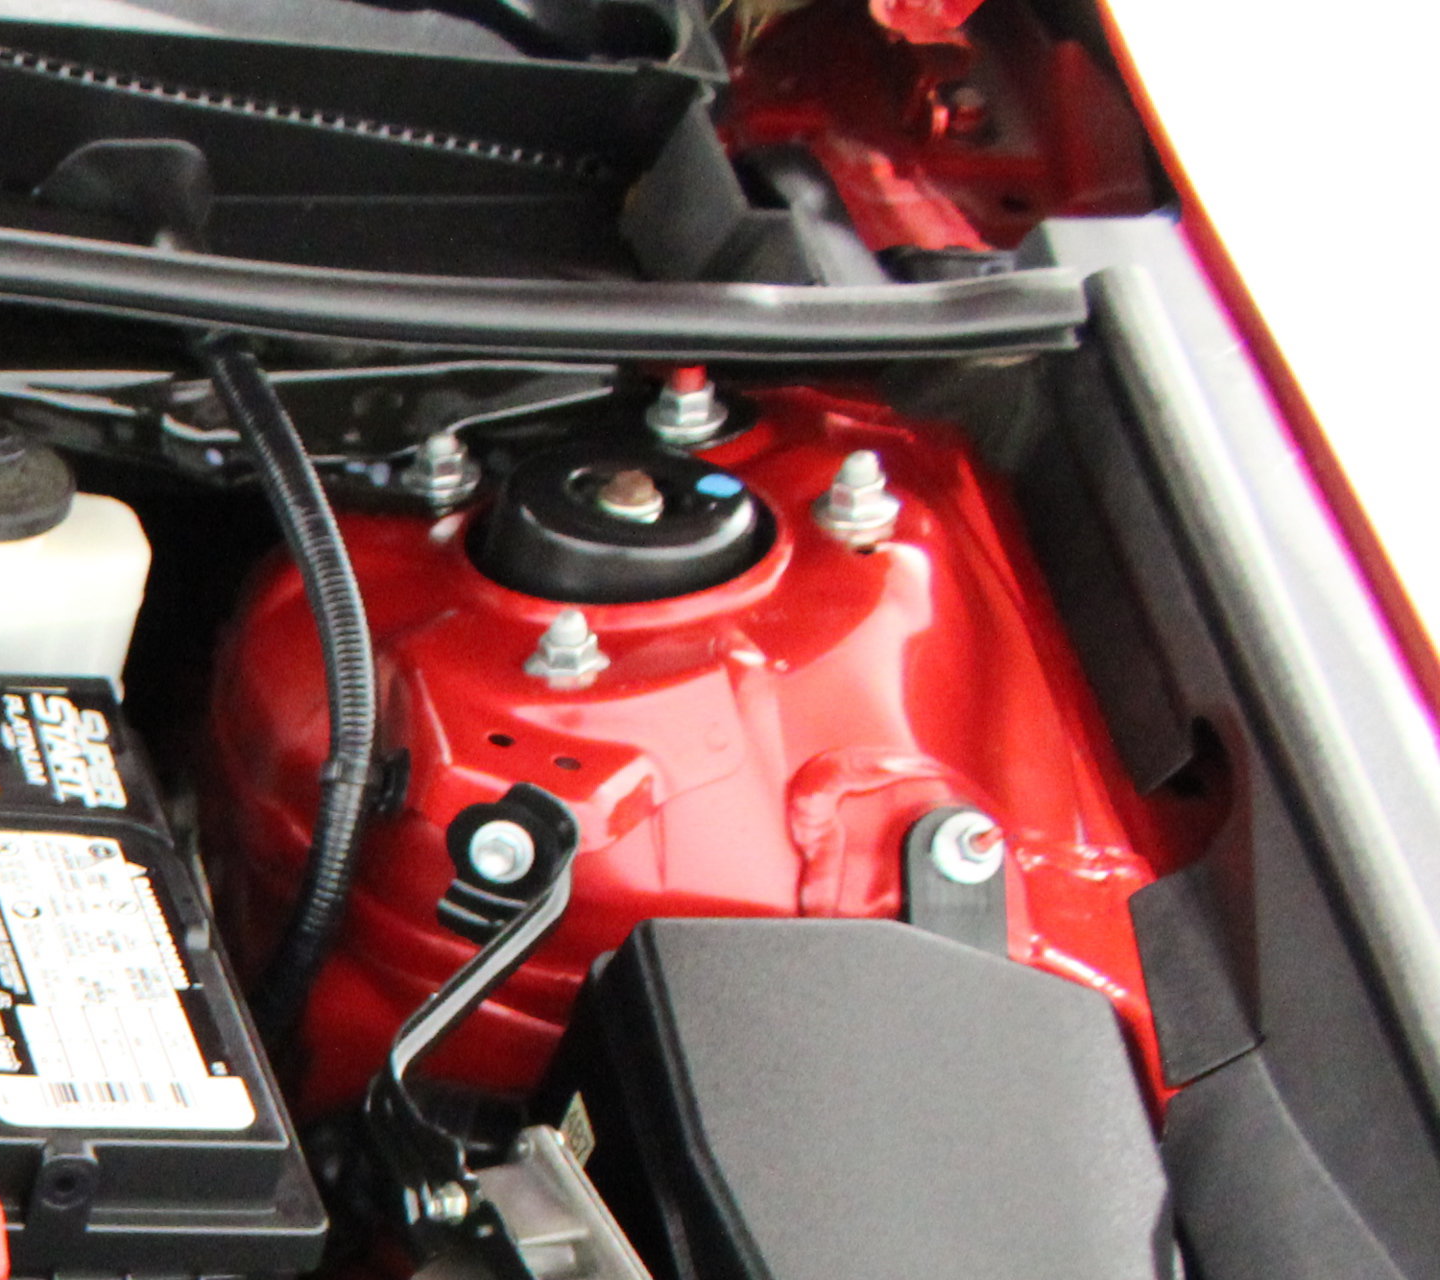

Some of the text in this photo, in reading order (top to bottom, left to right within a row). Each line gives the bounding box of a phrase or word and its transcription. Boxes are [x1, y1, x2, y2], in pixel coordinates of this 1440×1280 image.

[1, 693, 48, 786] PLATINUM
[30, 691, 99, 807] START
[79, 708, 127, 809] SUPER
